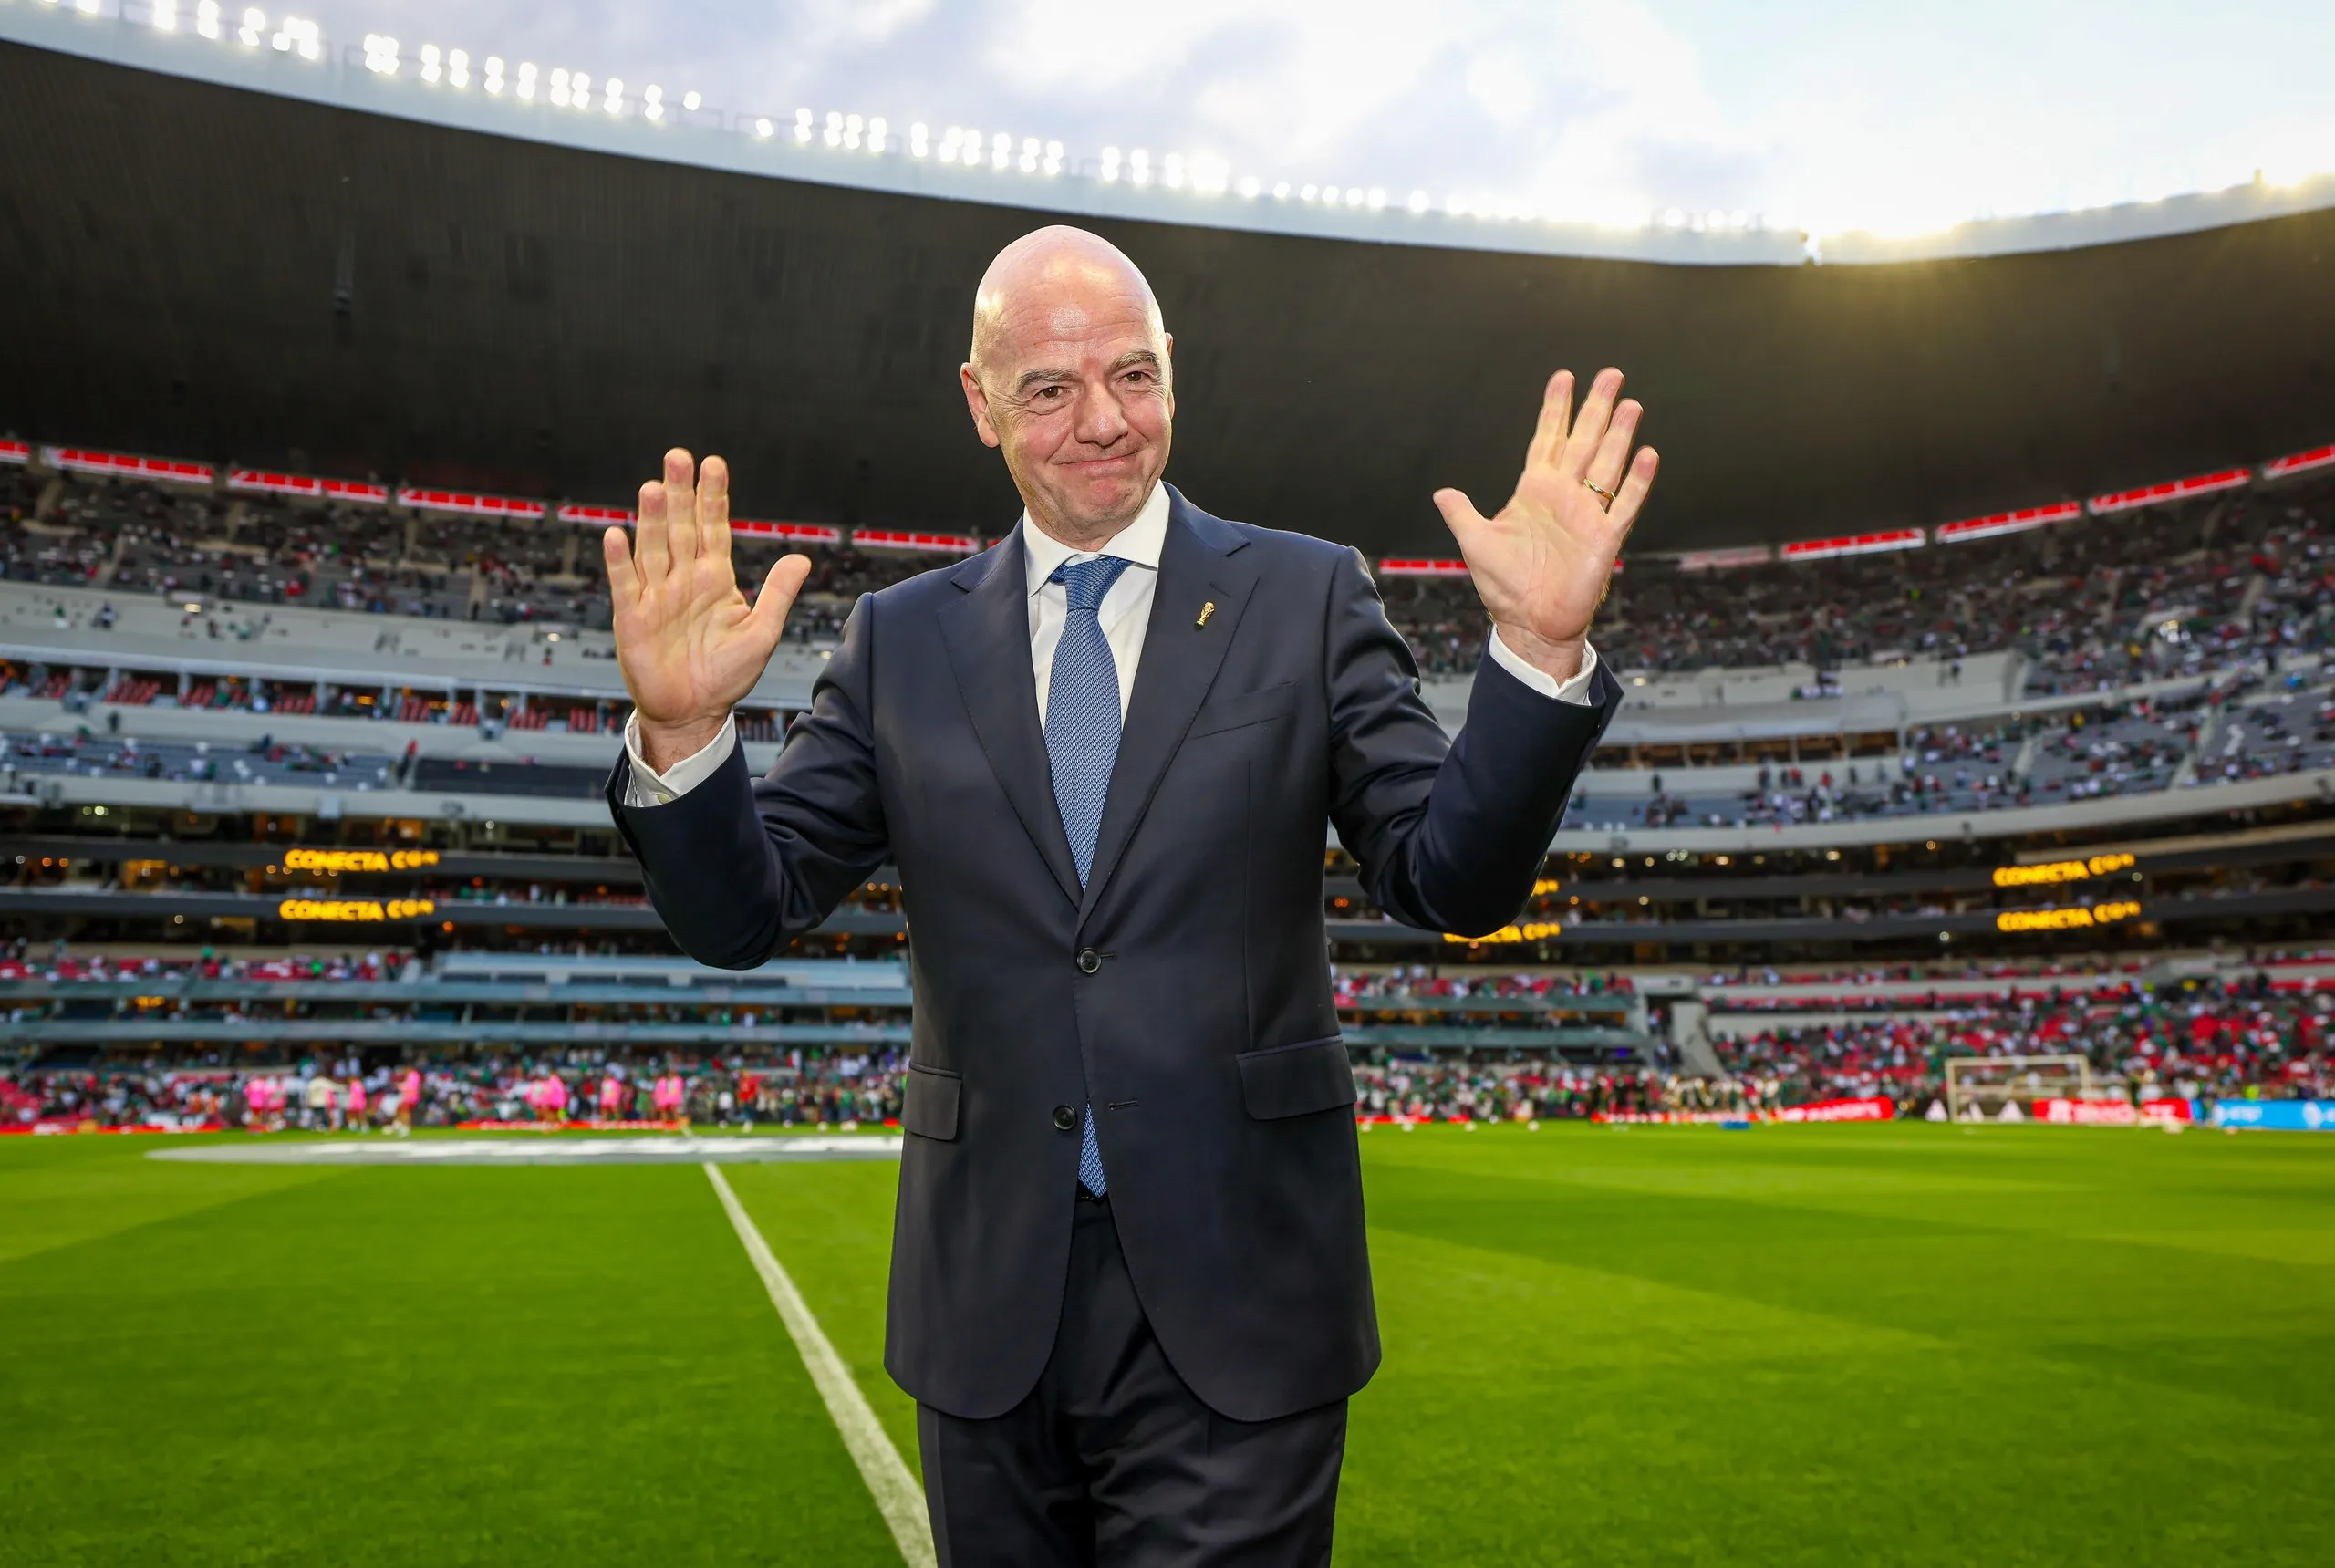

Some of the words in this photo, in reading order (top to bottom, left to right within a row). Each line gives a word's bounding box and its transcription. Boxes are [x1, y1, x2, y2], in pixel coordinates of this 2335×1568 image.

[285, 848, 389, 872] CONECTA
[1992, 860, 2091, 887] CONECTA
[279, 899, 385, 922] CONECTA
[1997, 908, 2095, 932] CONECTA
